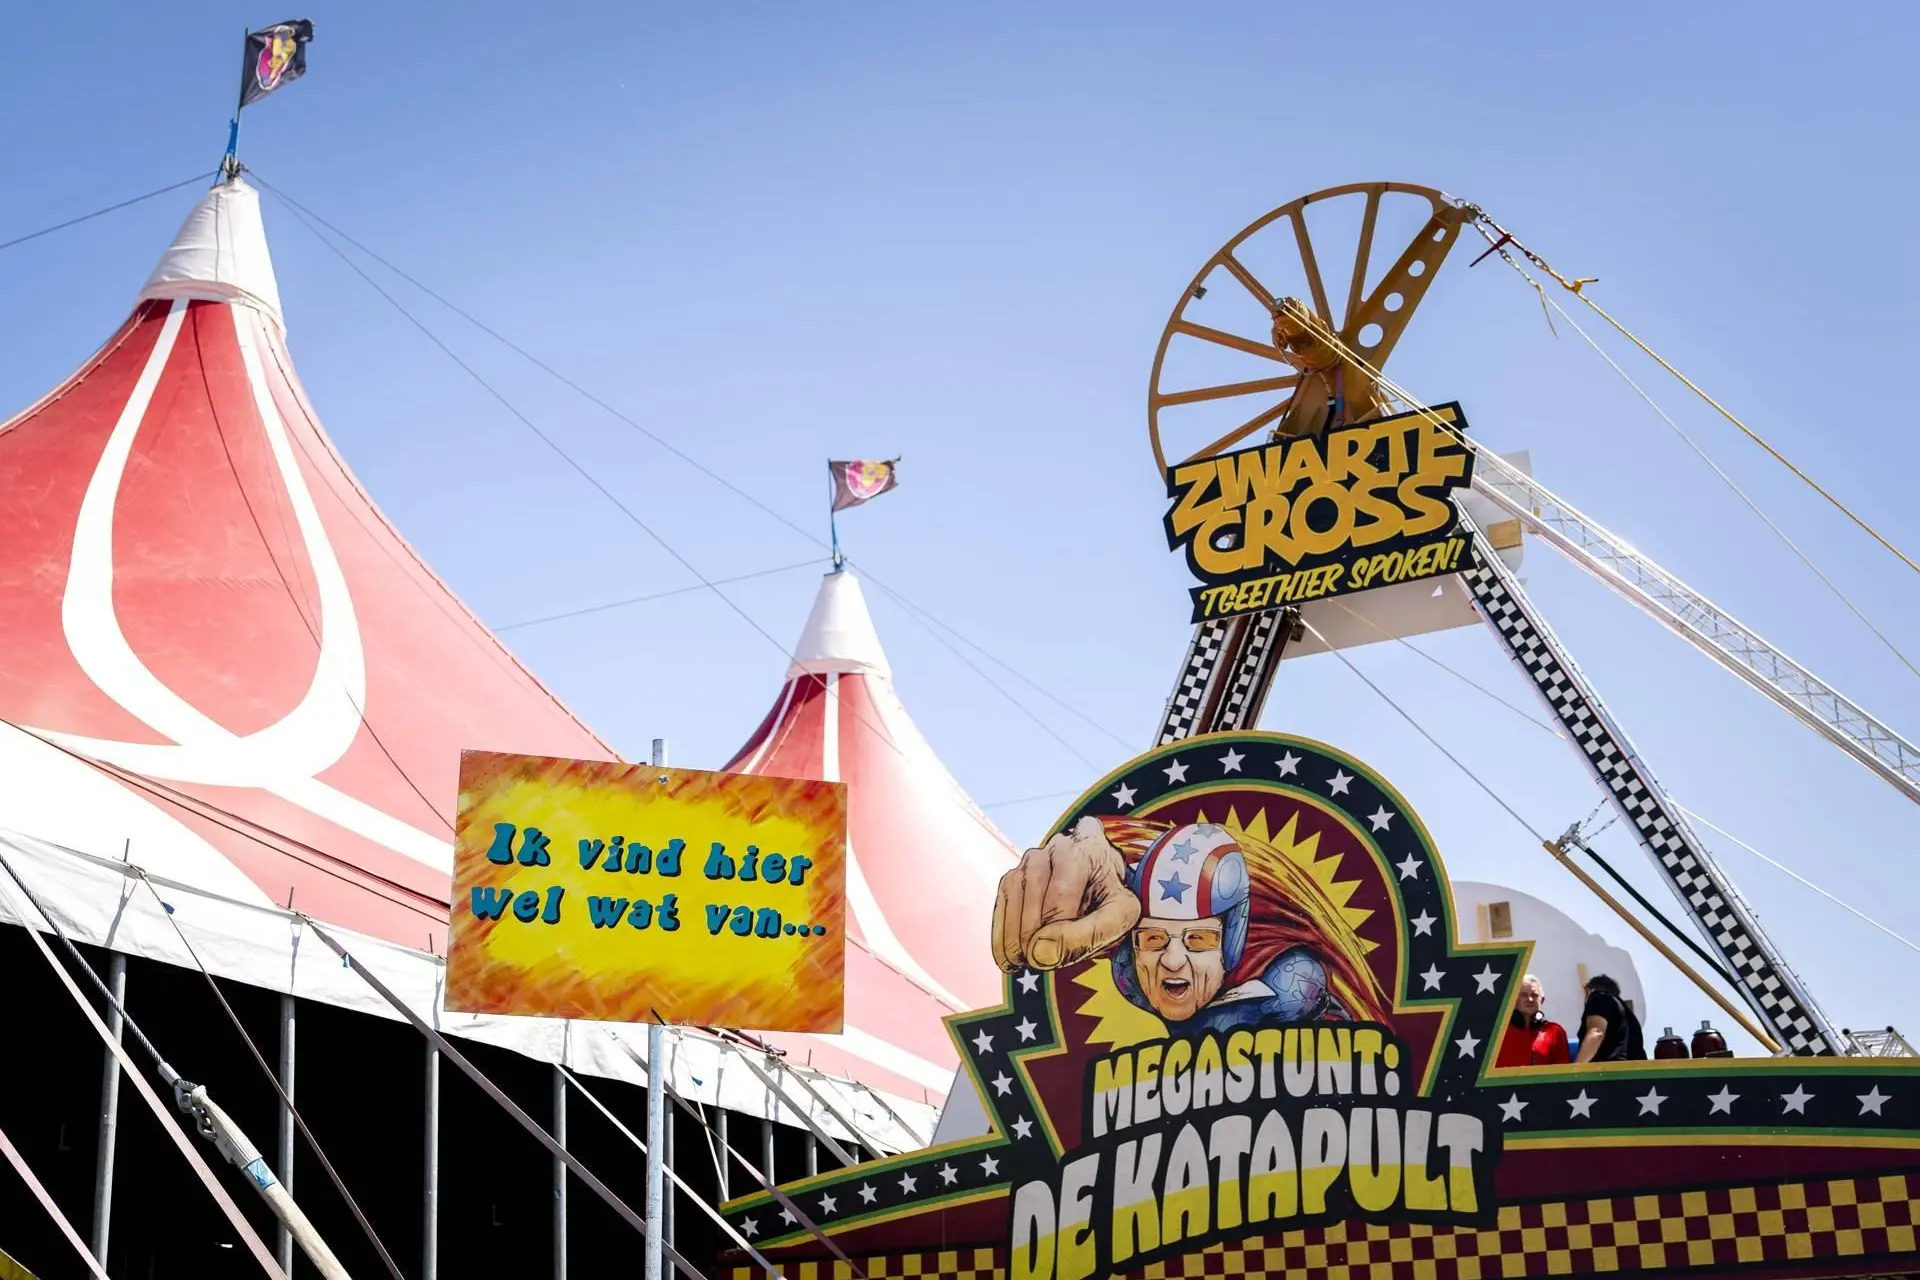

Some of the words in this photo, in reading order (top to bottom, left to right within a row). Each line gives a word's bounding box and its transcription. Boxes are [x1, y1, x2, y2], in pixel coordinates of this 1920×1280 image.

[1171, 407, 1466, 537] ZWARTE
[1193, 472, 1451, 574] CROSS
[486, 822, 552, 867] Ik
[578, 836, 686, 877] vind
[703, 842, 812, 886] hier
[587, 893, 680, 931] wat
[1093, 1027, 1401, 1138] MEGASTUNT:
[1010, 1152, 1101, 1280] DE
[1111, 1106, 1484, 1264] KATAPULT
